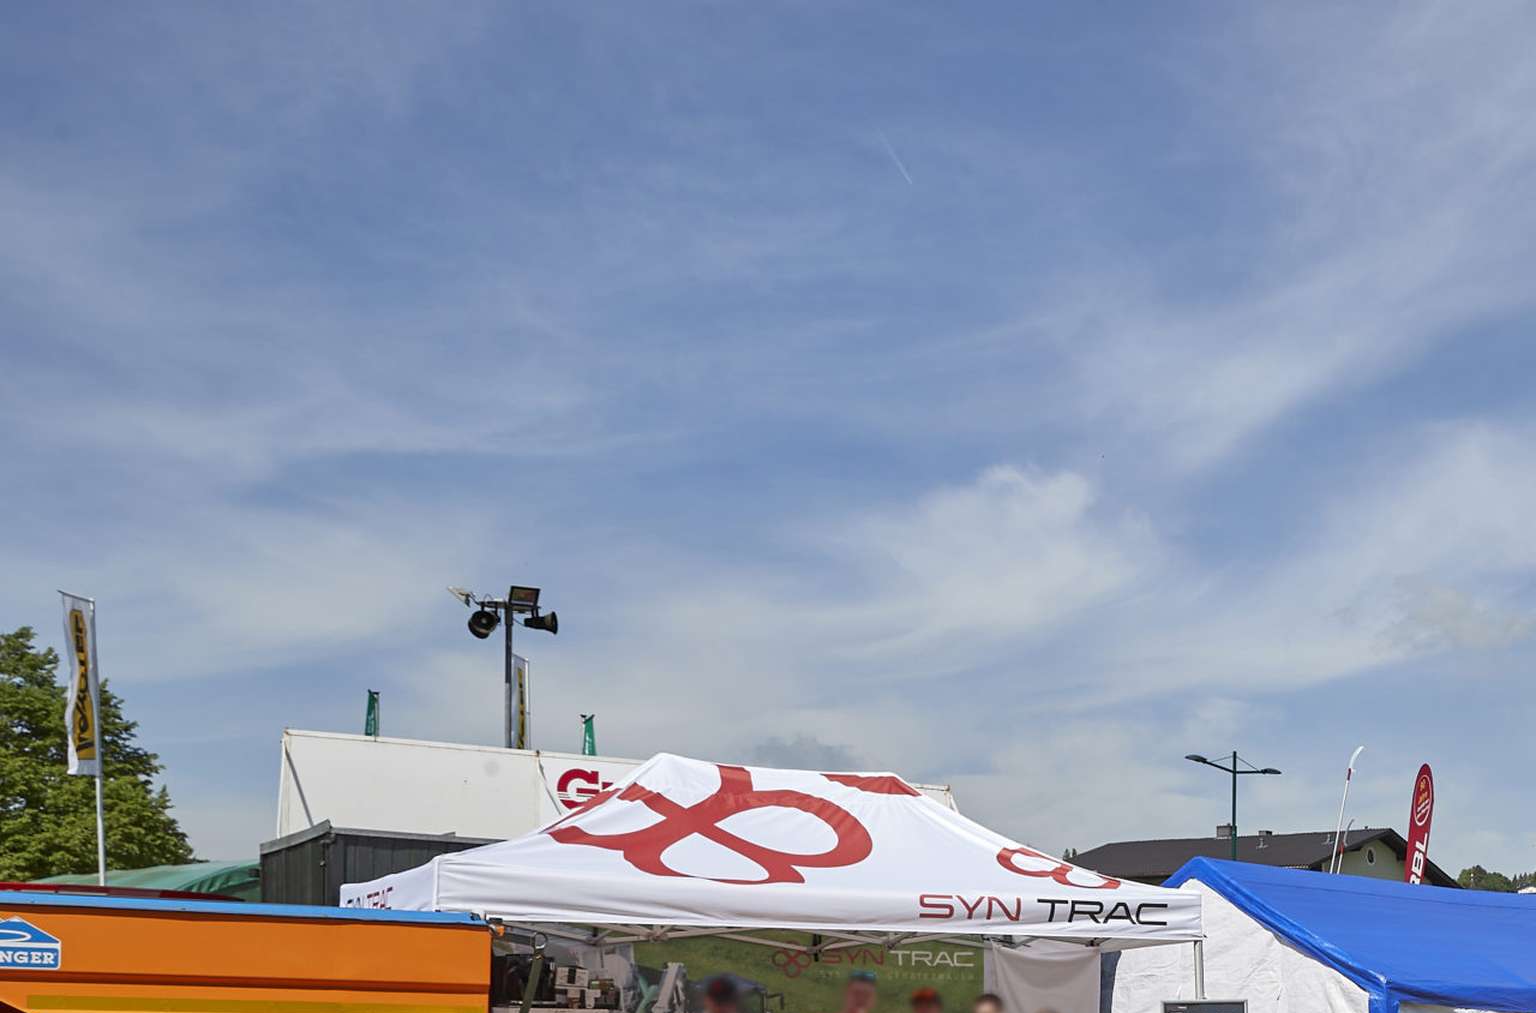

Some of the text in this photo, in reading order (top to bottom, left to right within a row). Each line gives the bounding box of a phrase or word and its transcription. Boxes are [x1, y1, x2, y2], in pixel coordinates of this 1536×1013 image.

[919, 894, 1169, 926] SYN TRAC
[890, 951, 975, 967] TRAC
